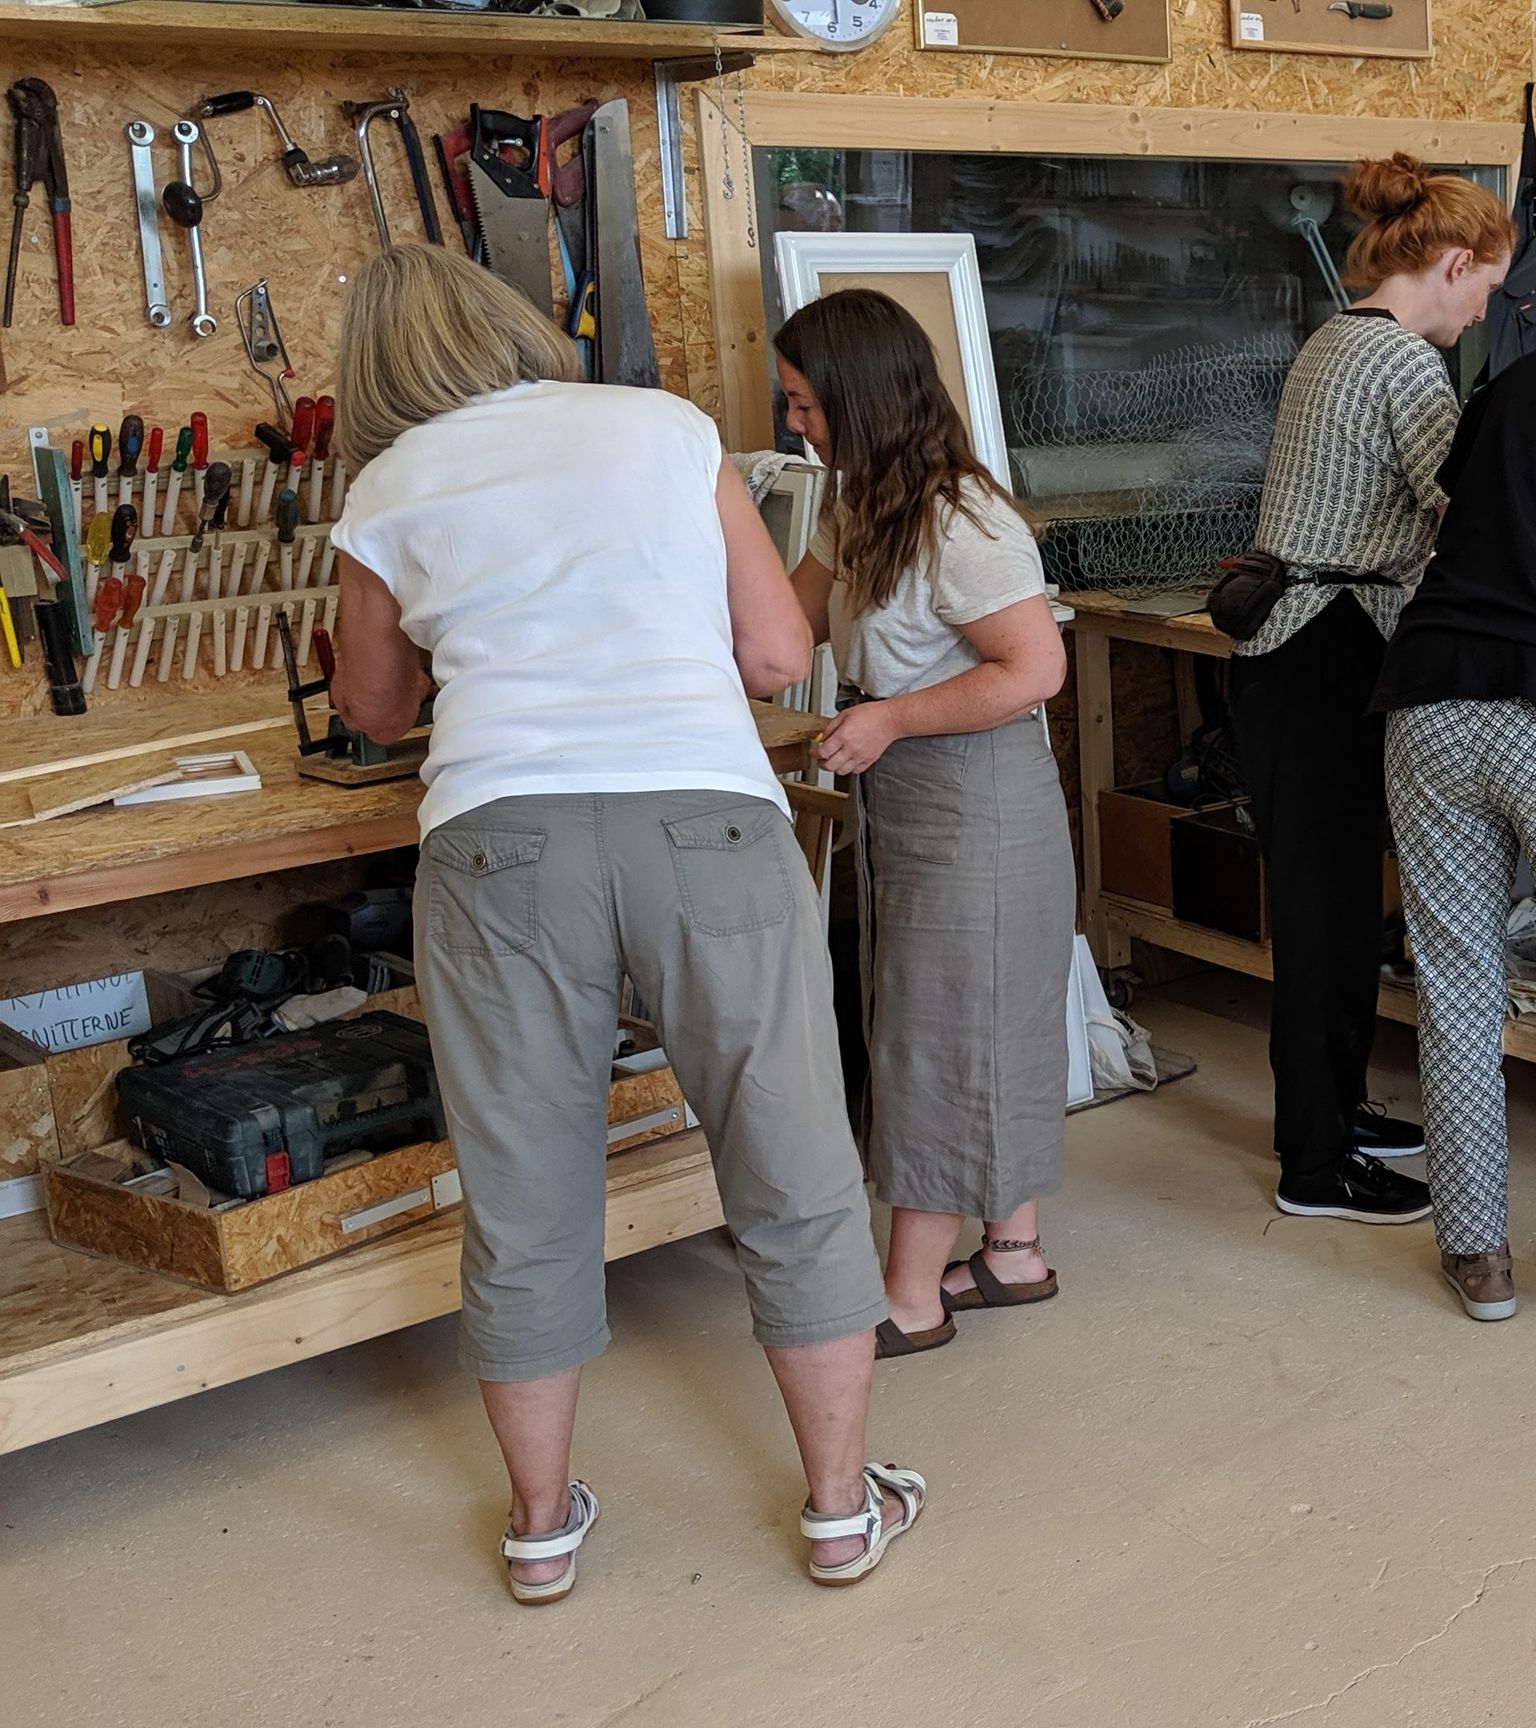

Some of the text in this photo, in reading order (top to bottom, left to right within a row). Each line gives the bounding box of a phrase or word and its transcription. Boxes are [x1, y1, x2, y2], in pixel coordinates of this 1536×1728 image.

[801, 11, 810, 22] 7
[852, 16, 863, 27] 5
[827, 21, 837, 33] 6
